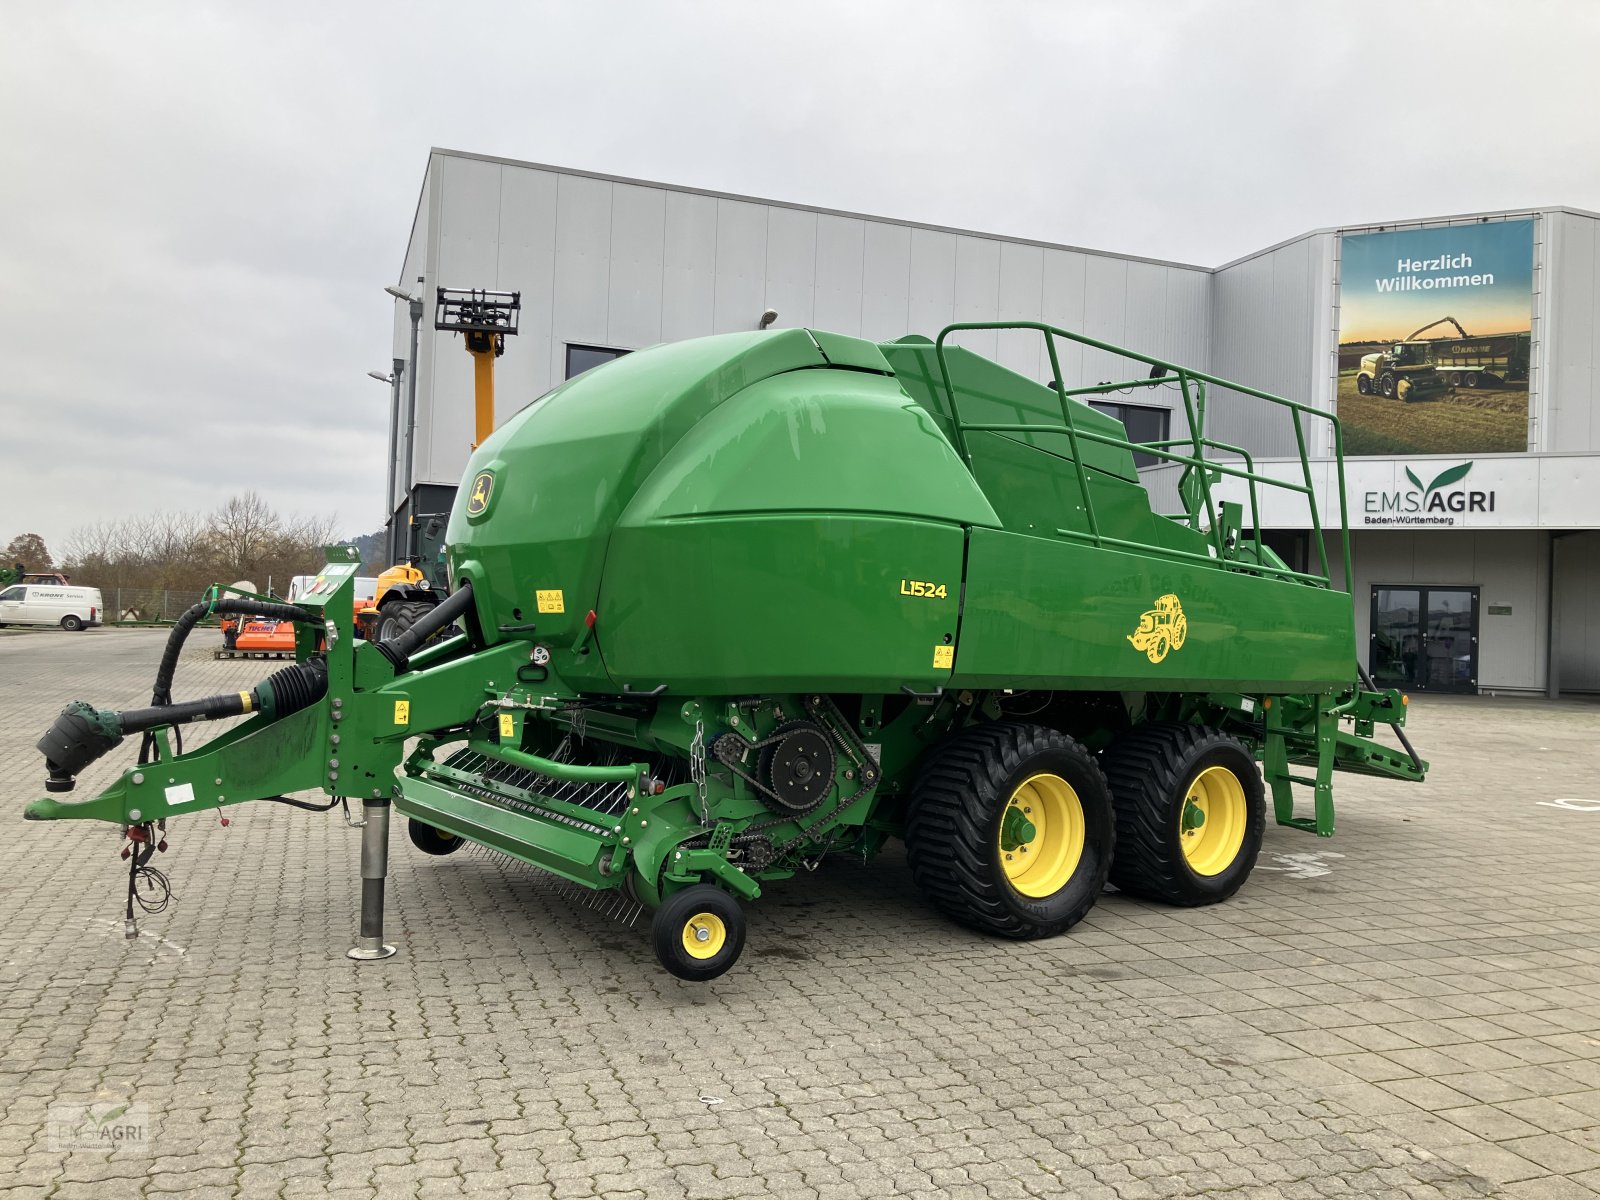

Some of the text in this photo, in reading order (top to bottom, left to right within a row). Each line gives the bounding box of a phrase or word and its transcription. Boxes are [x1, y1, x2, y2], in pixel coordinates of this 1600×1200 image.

[1397, 253, 1472, 273] Herzlich
[1375, 273, 1494, 292] Willkommen
[1427, 491, 1495, 512] AGRI
[1364, 516, 1454, 525] Baden-Württemberg
[900, 579, 948, 599] L1524
